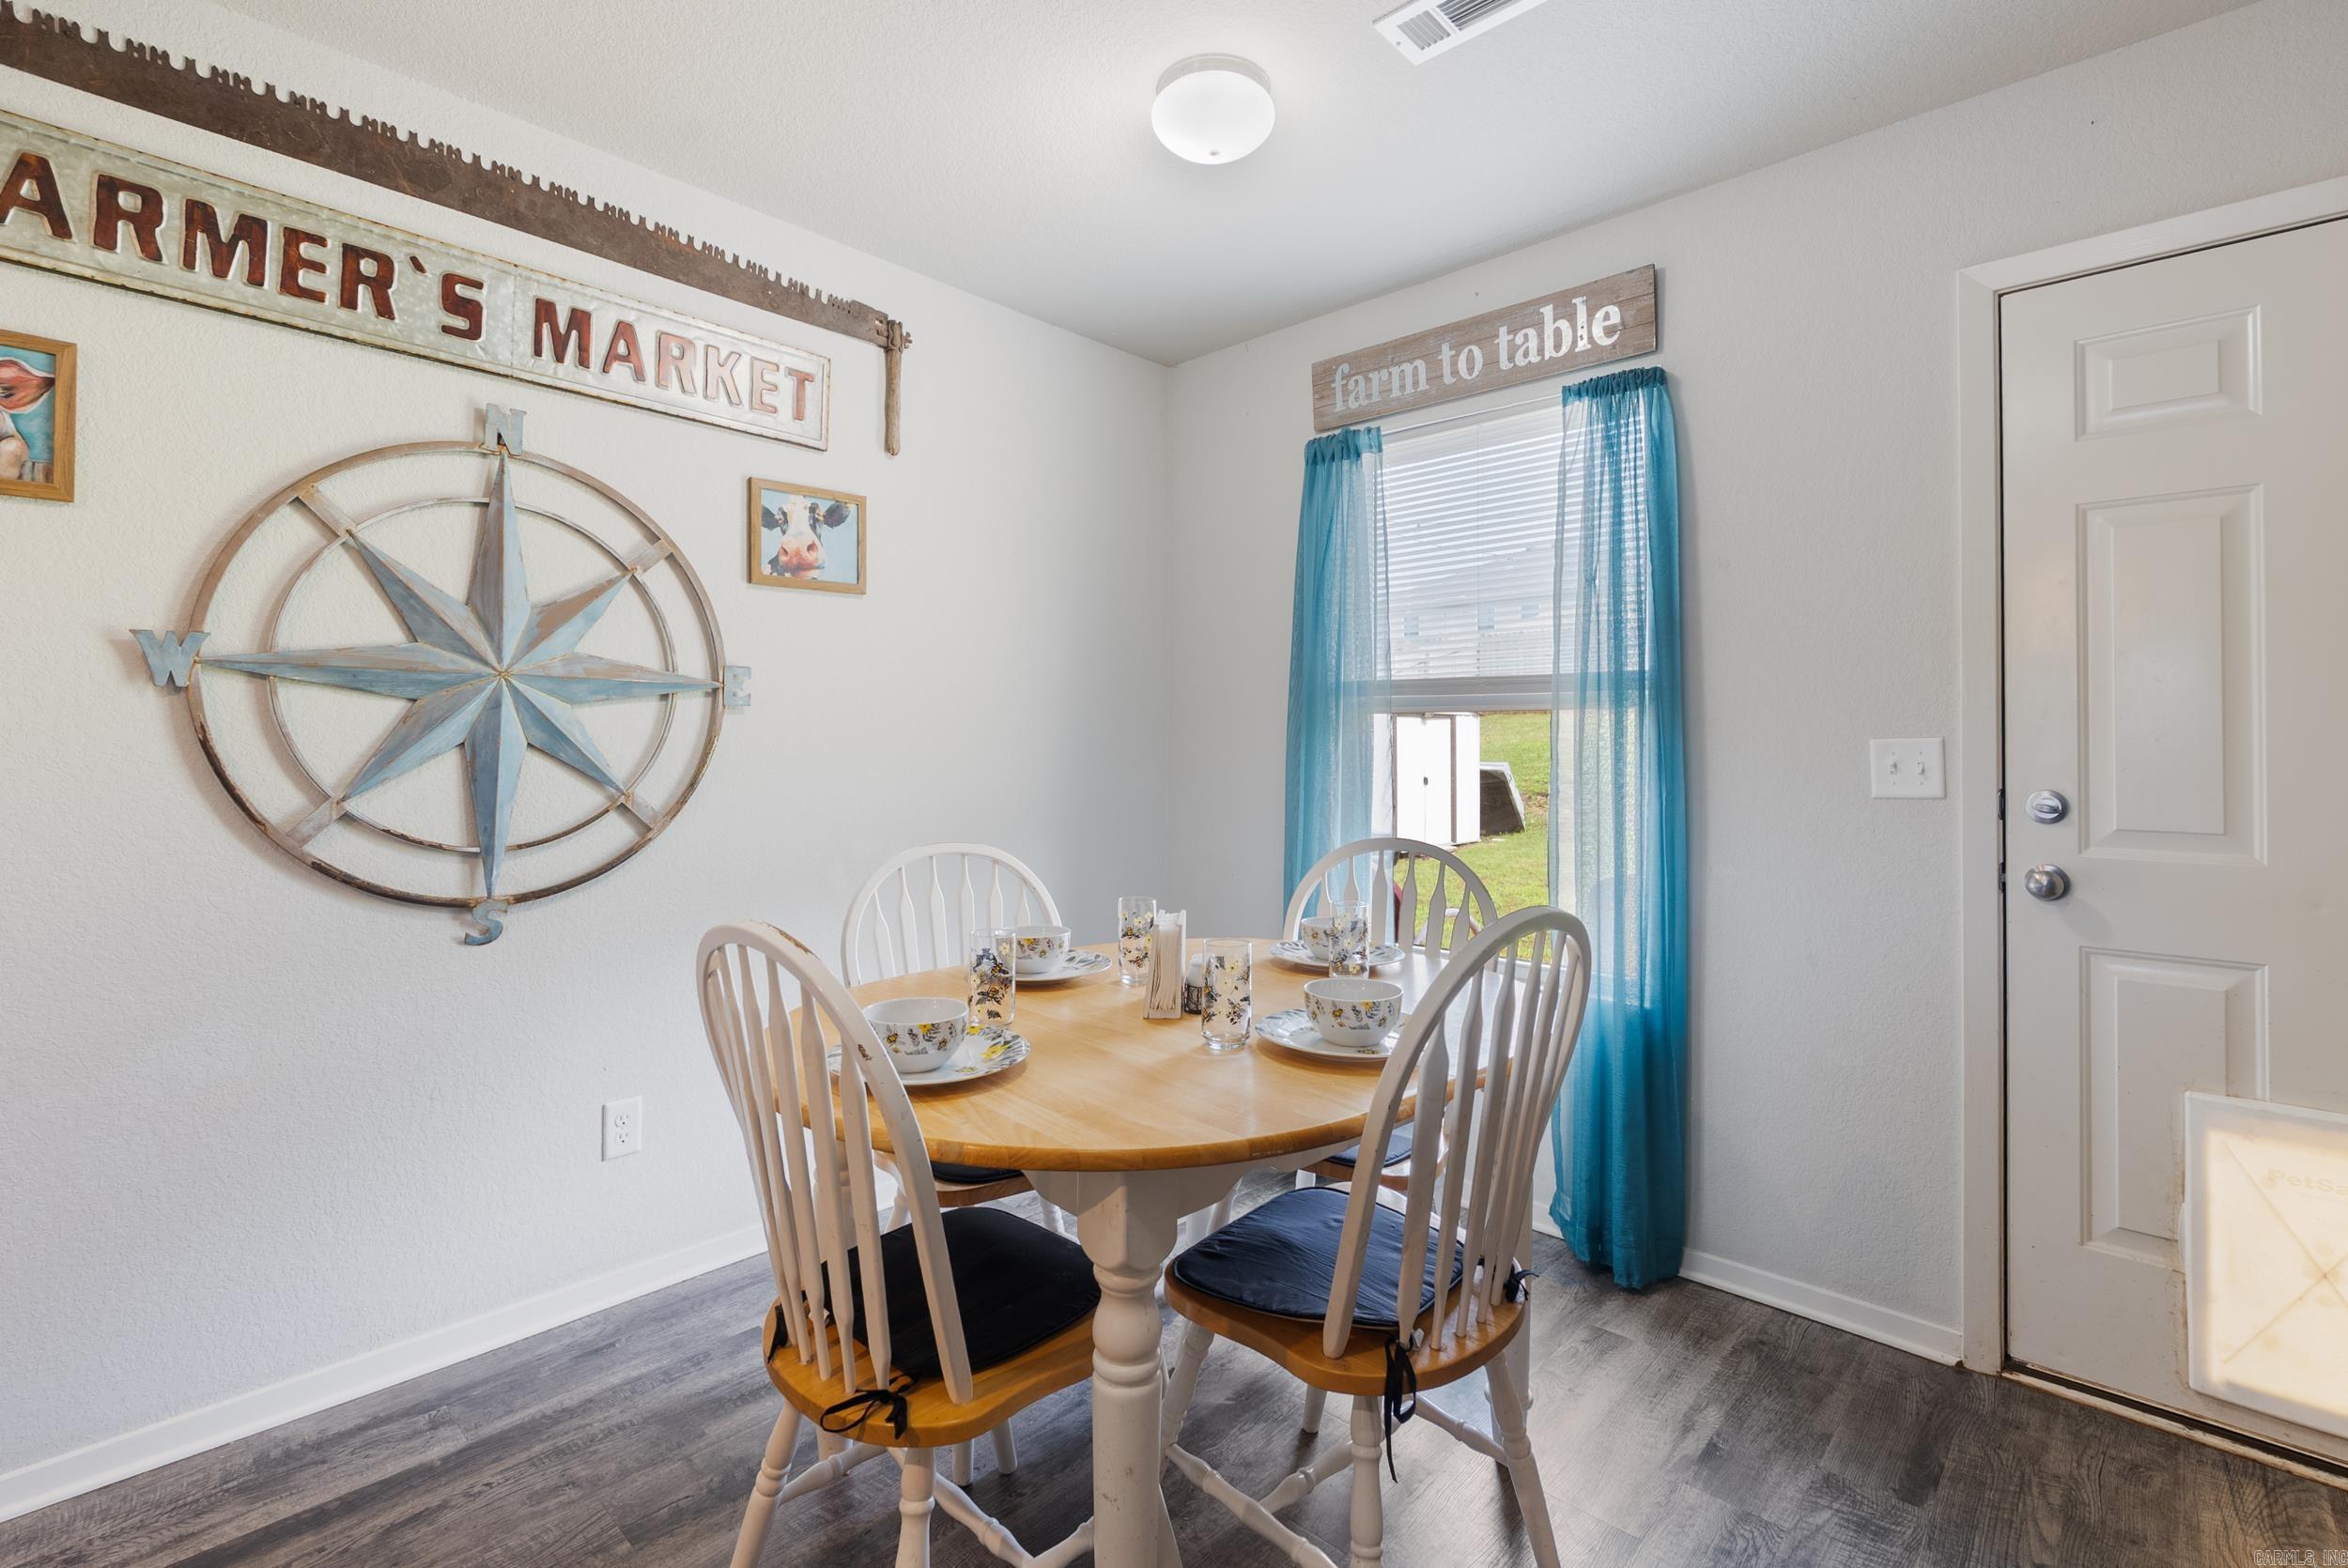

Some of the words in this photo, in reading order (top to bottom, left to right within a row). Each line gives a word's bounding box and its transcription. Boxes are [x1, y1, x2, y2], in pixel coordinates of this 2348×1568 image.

[533, 296, 815, 422] MARKET
[1331, 362, 1429, 412] farm
[1438, 342, 1484, 385] to
[1494, 296, 1622, 371] table
[480, 403, 527, 457] N
[129, 629, 211, 687] W
[723, 665, 751, 706] E
[465, 899, 508, 945] S
